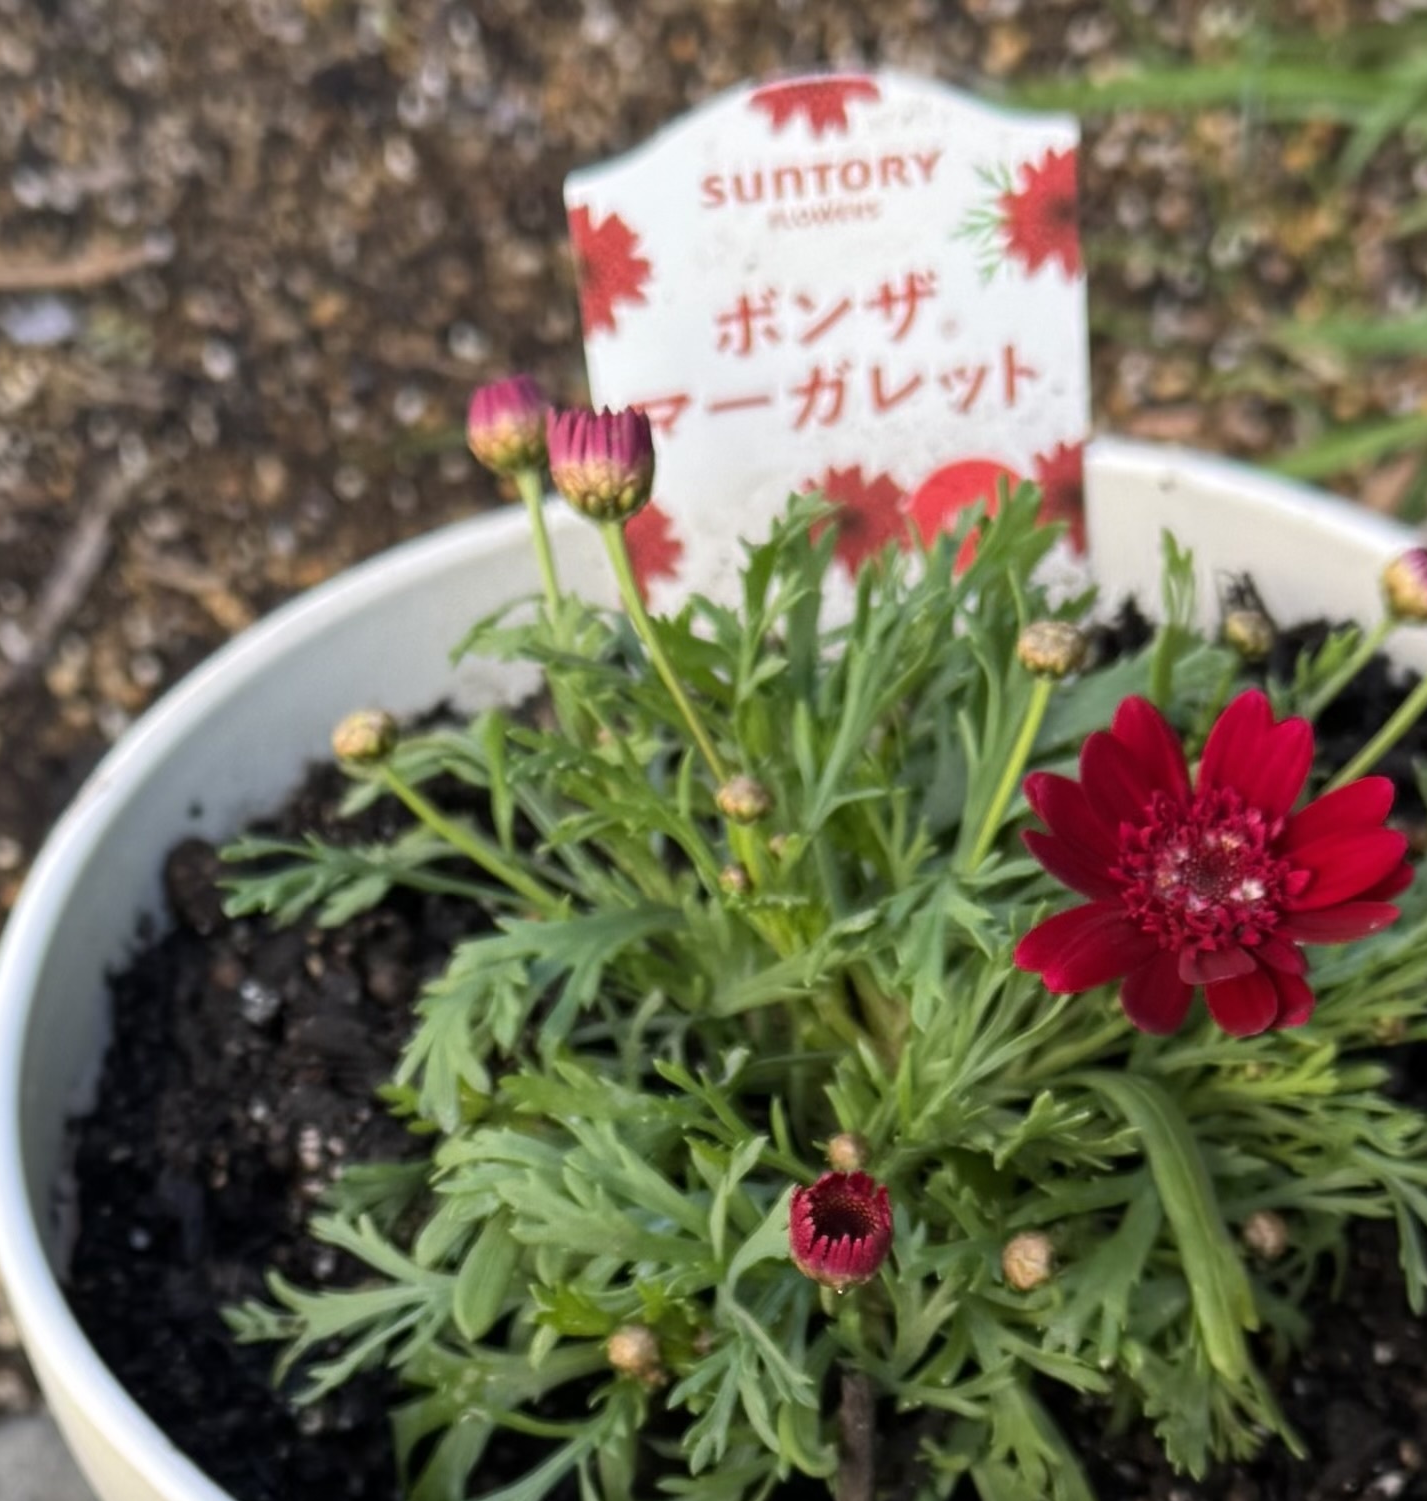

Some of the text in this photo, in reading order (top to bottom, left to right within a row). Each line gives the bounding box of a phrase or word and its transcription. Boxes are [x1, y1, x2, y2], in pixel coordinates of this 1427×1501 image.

[701, 150, 944, 208] SUNTORY
[627, 345, 1038, 433] マーガレット
